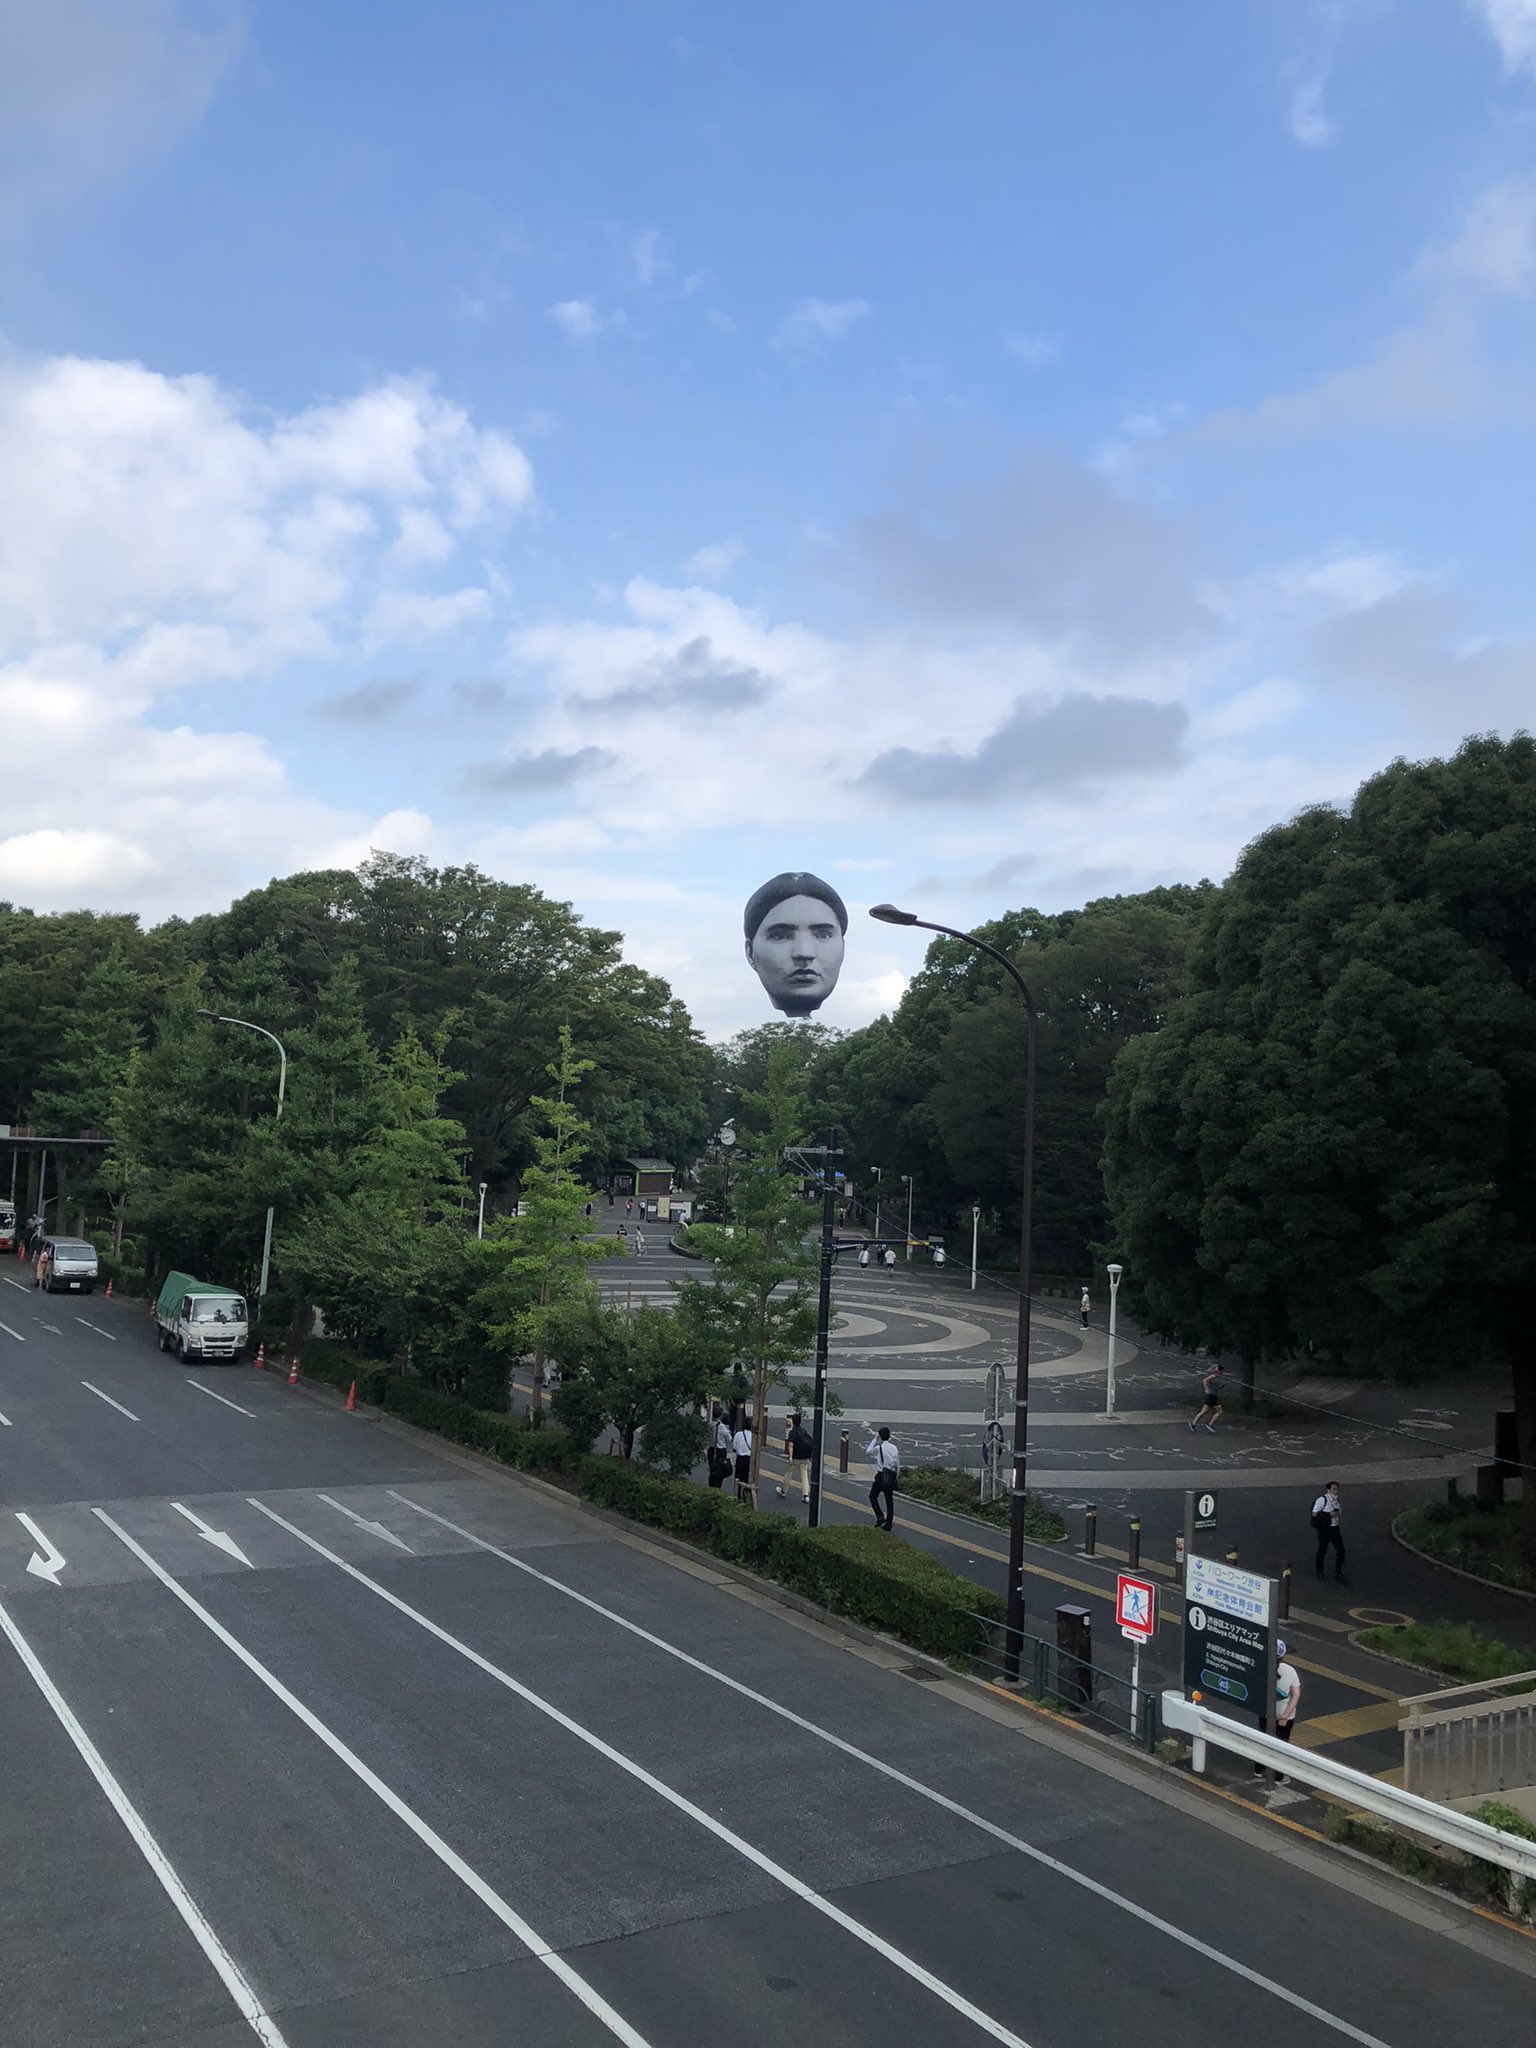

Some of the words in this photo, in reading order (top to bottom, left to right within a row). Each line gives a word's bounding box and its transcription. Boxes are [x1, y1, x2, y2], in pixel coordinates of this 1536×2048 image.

[1206, 1623, 1227, 1637] Shibuya
[1227, 1631, 1239, 1642] City
[1239, 1636, 1252, 1646] Area
[1252, 1640, 1265, 1651] Map
[1207, 1615, 1260, 1640] 渋谷区エリアマップ
